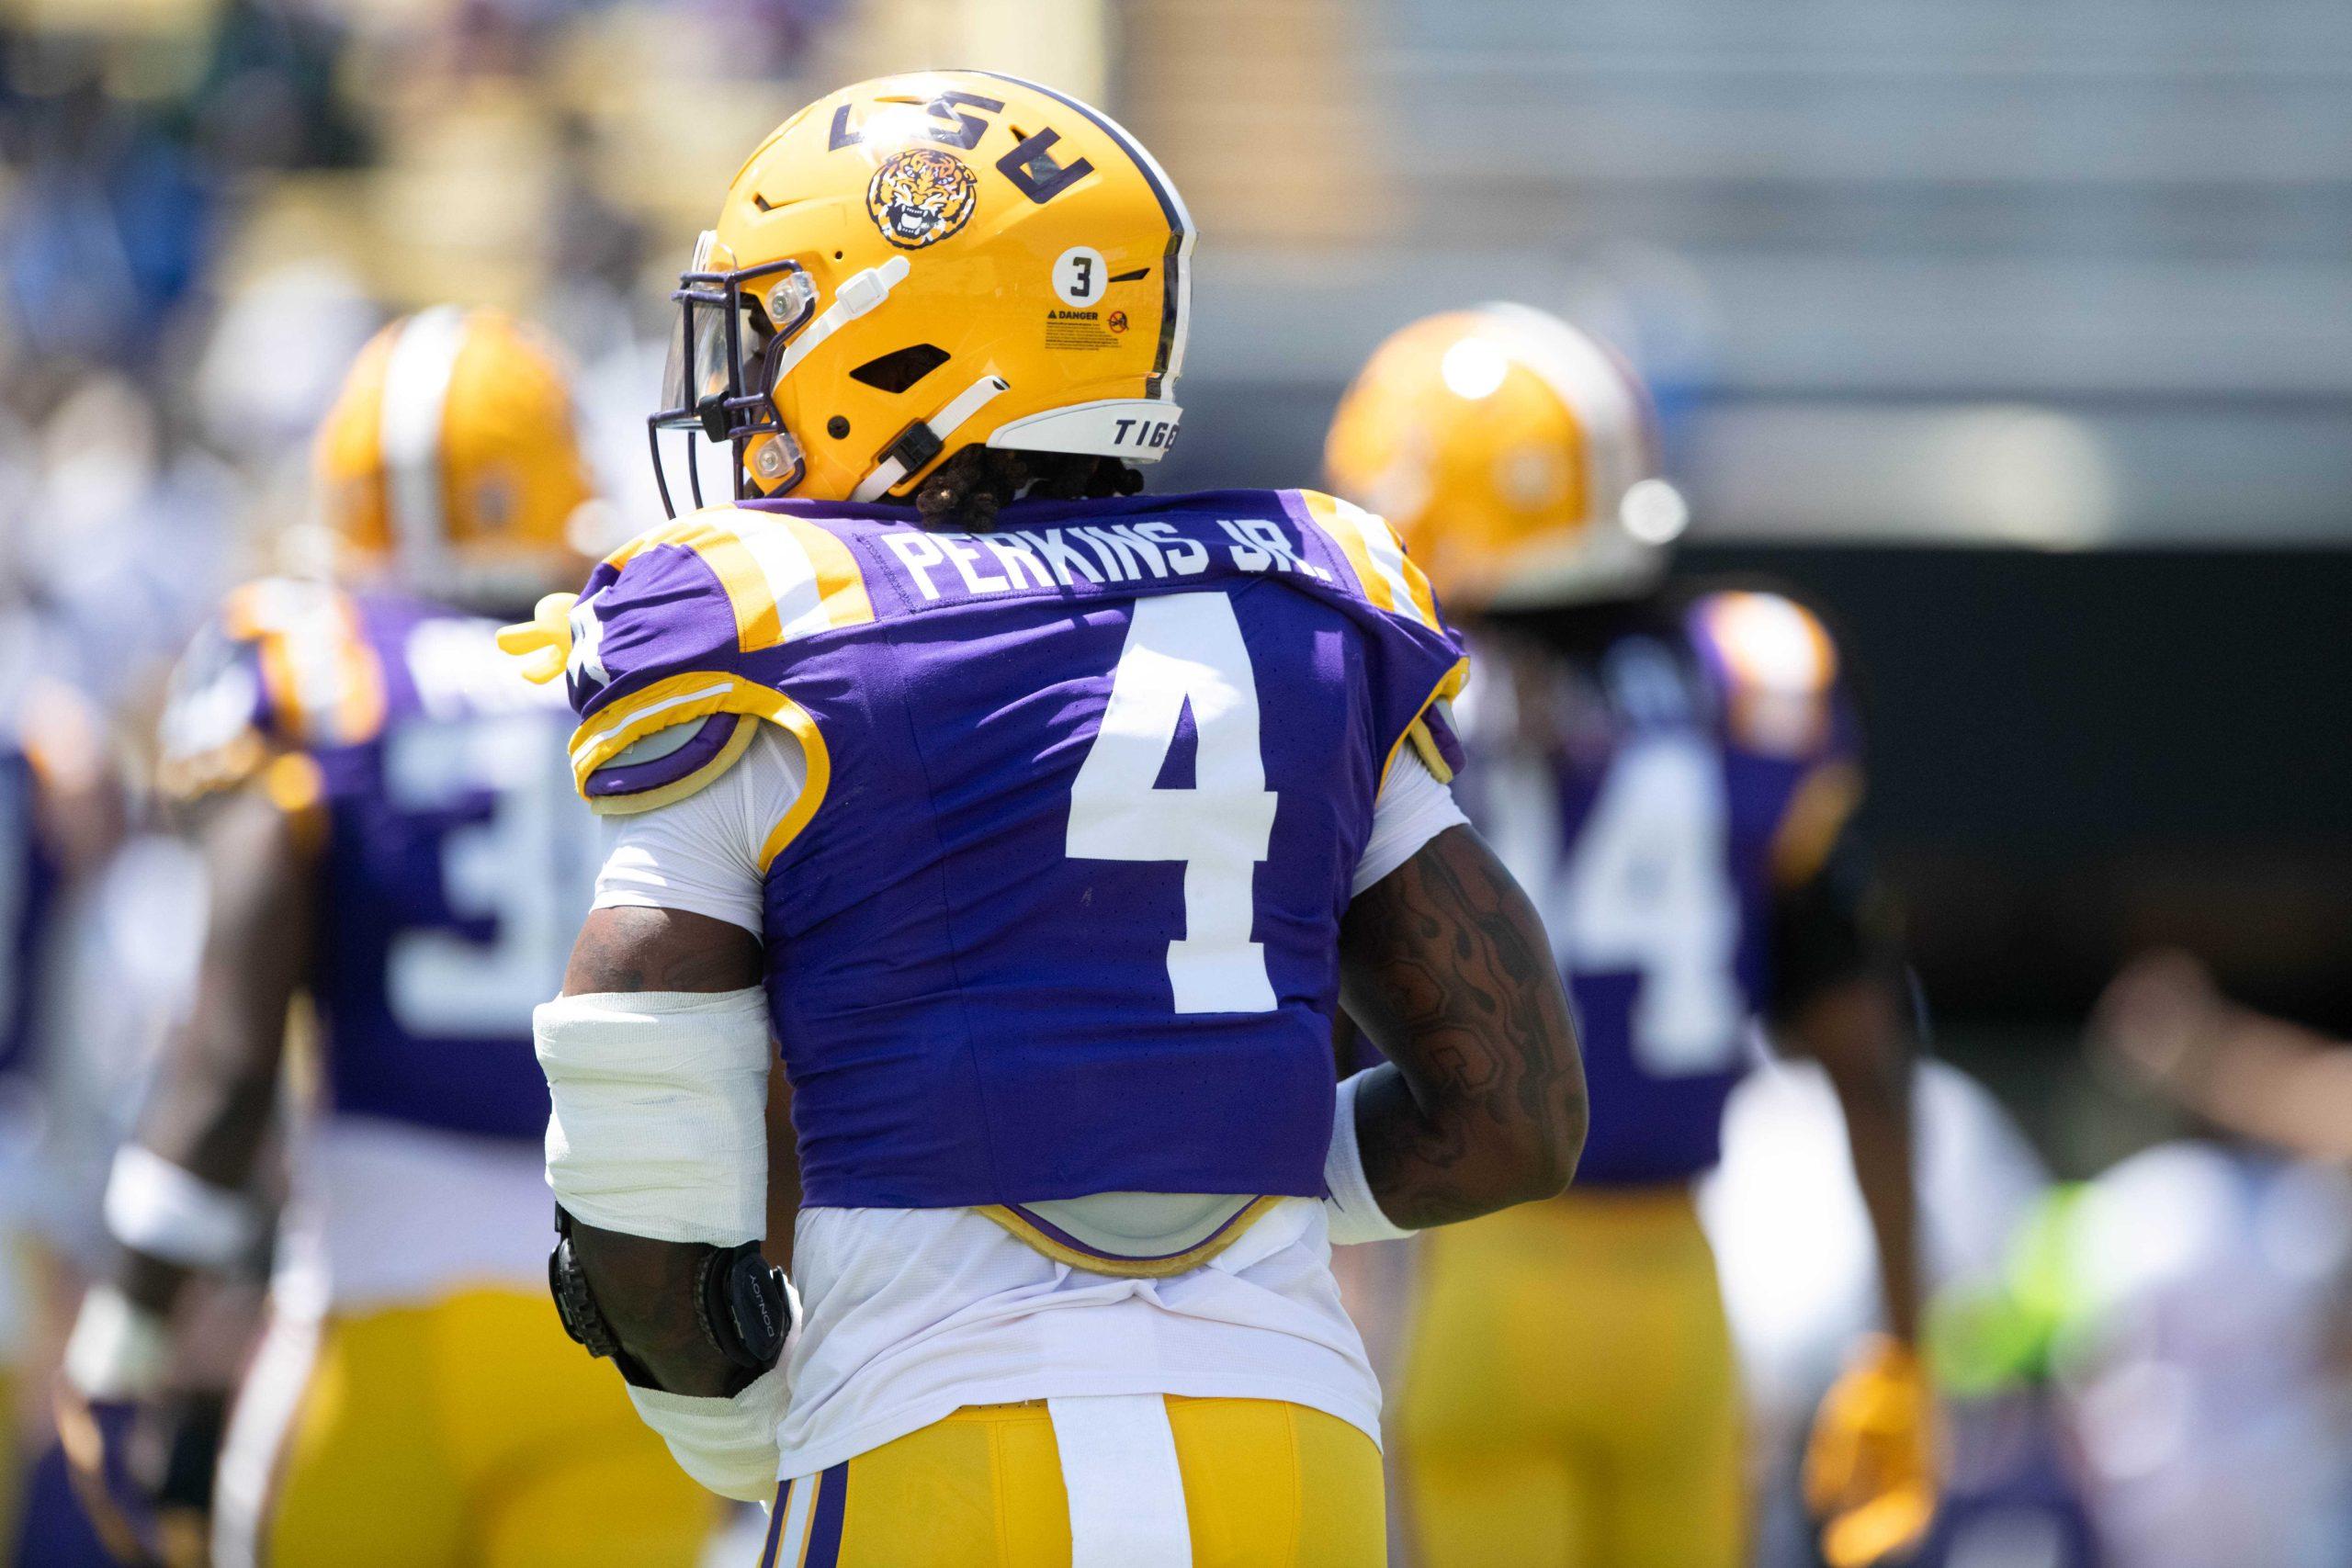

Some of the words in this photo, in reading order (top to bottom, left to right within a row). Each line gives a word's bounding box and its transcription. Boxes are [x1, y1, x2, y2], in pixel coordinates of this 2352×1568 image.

[828, 90, 1095, 204] LSU
[1070, 256, 1091, 297] 3
[1058, 311, 1098, 321] DANGER
[881, 521, 1210, 601] PERKINS
[1216, 519, 1333, 582] JR.
[1065, 591, 1279, 1015] 4
[749, 1273, 775, 1337] DONJOY
